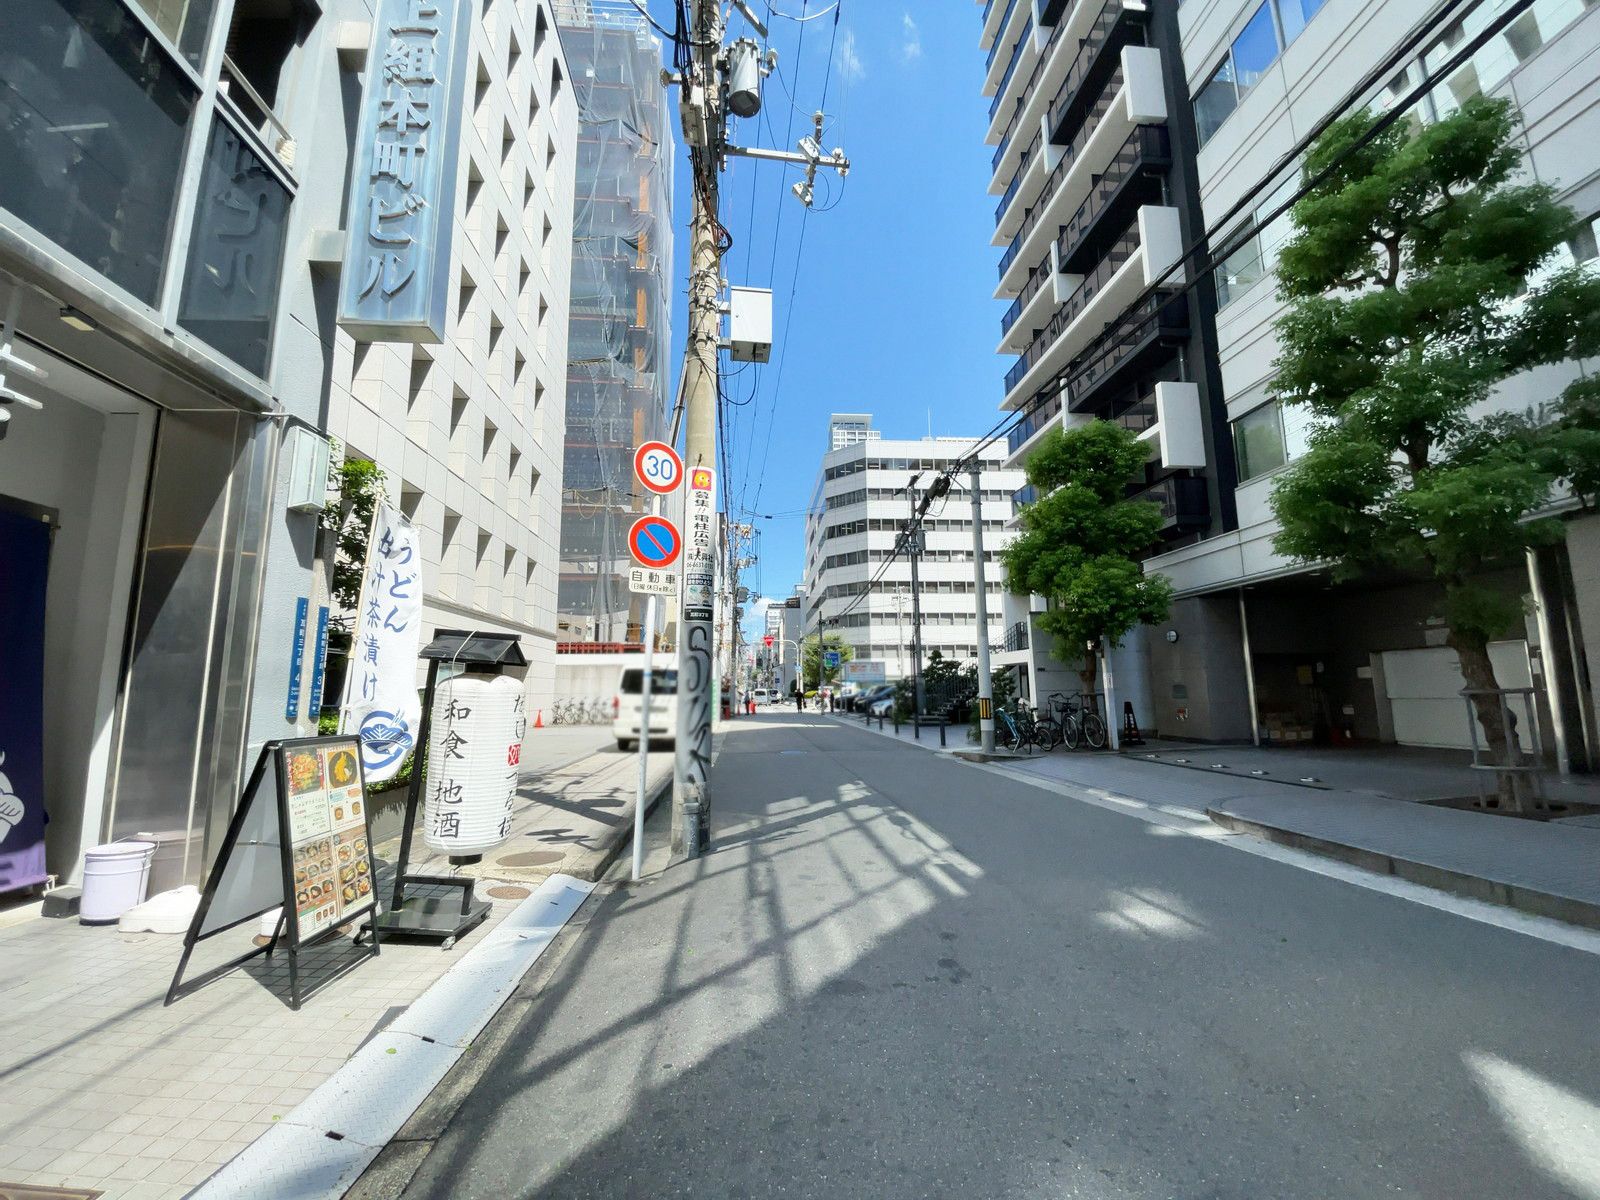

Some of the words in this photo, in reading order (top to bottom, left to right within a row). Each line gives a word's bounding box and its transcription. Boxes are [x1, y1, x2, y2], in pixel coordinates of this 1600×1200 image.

[646, 455, 673, 480] 30
[383, 537, 415, 634] うどん
[632, 570, 676, 585] 自動車
[362, 526, 394, 703] 出汁茶漬け
[295, 672, 300, 683] 4
[317, 675, 322, 685] 3
[439, 698, 472, 760] 和食
[433, 778, 463, 839] 地酒
